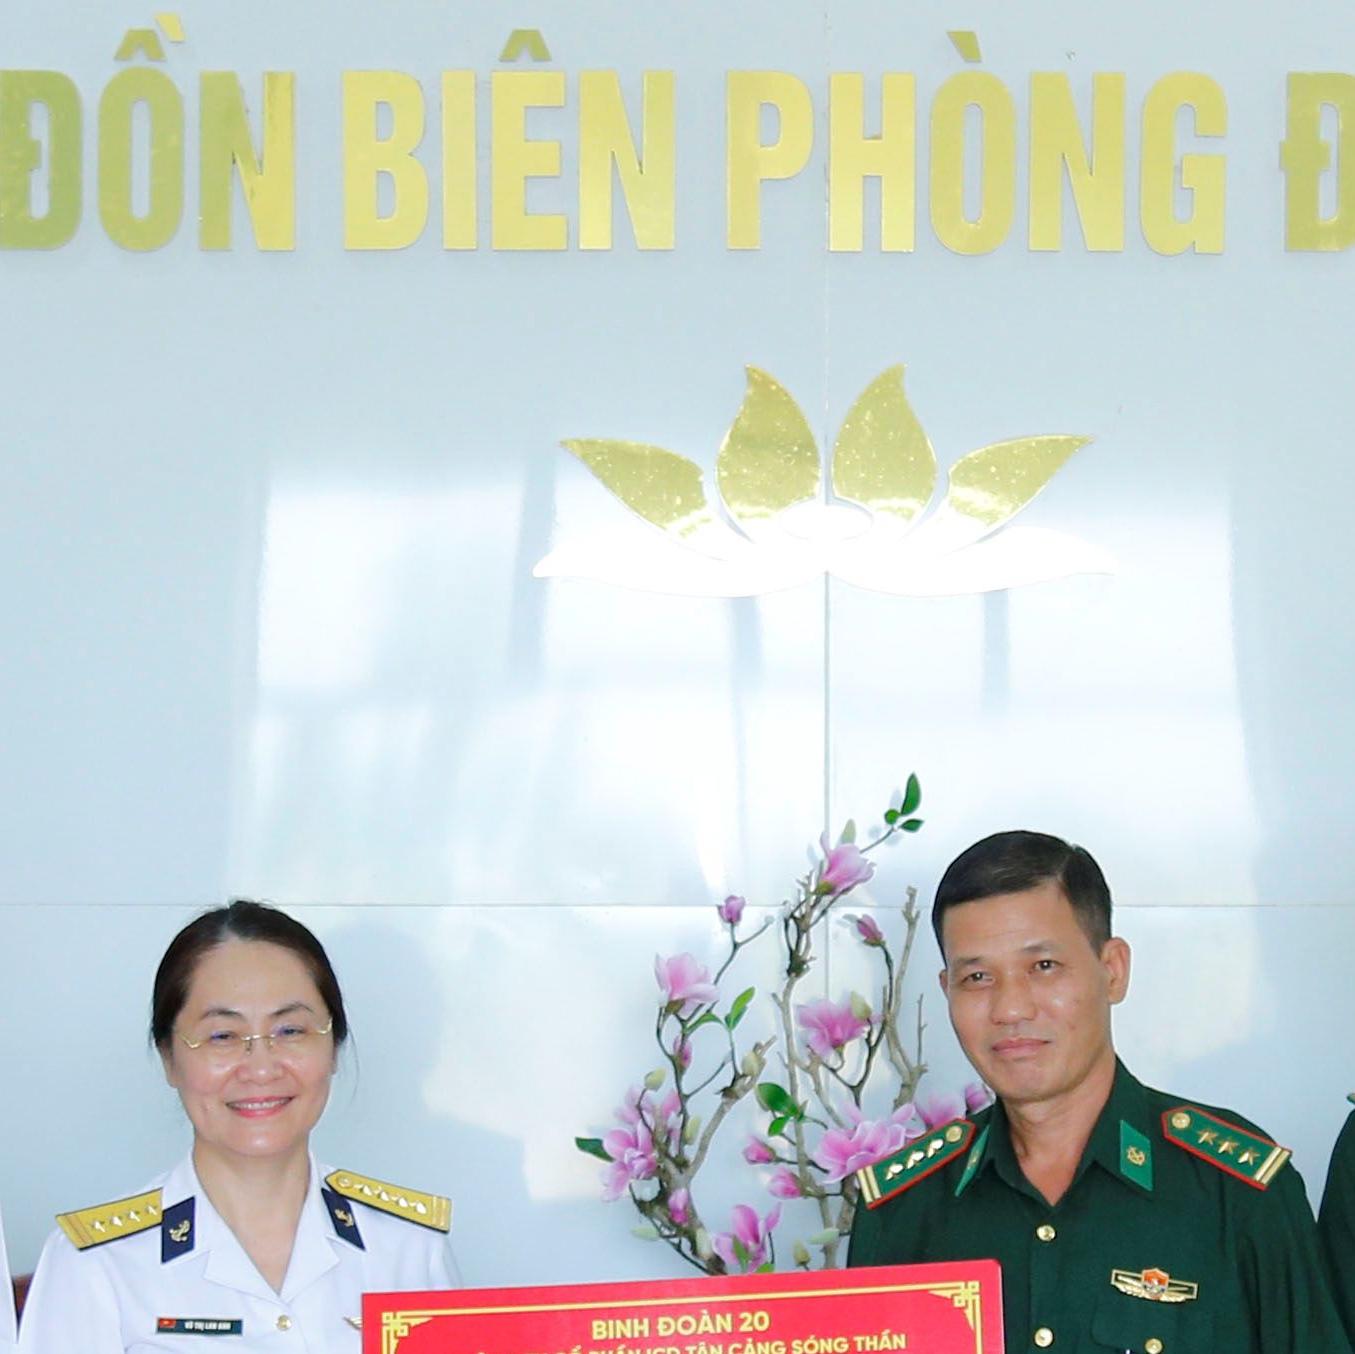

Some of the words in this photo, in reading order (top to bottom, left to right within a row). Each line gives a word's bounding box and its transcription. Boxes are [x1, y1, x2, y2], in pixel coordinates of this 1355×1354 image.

[343, 29, 675, 252] BIÊN
[726, 31, 1228, 256] PHÒNG
[591, 1316, 650, 1341] BINH
[657, 1309, 733, 1337] ĐOÀN
[739, 1311, 770, 1333] 20
